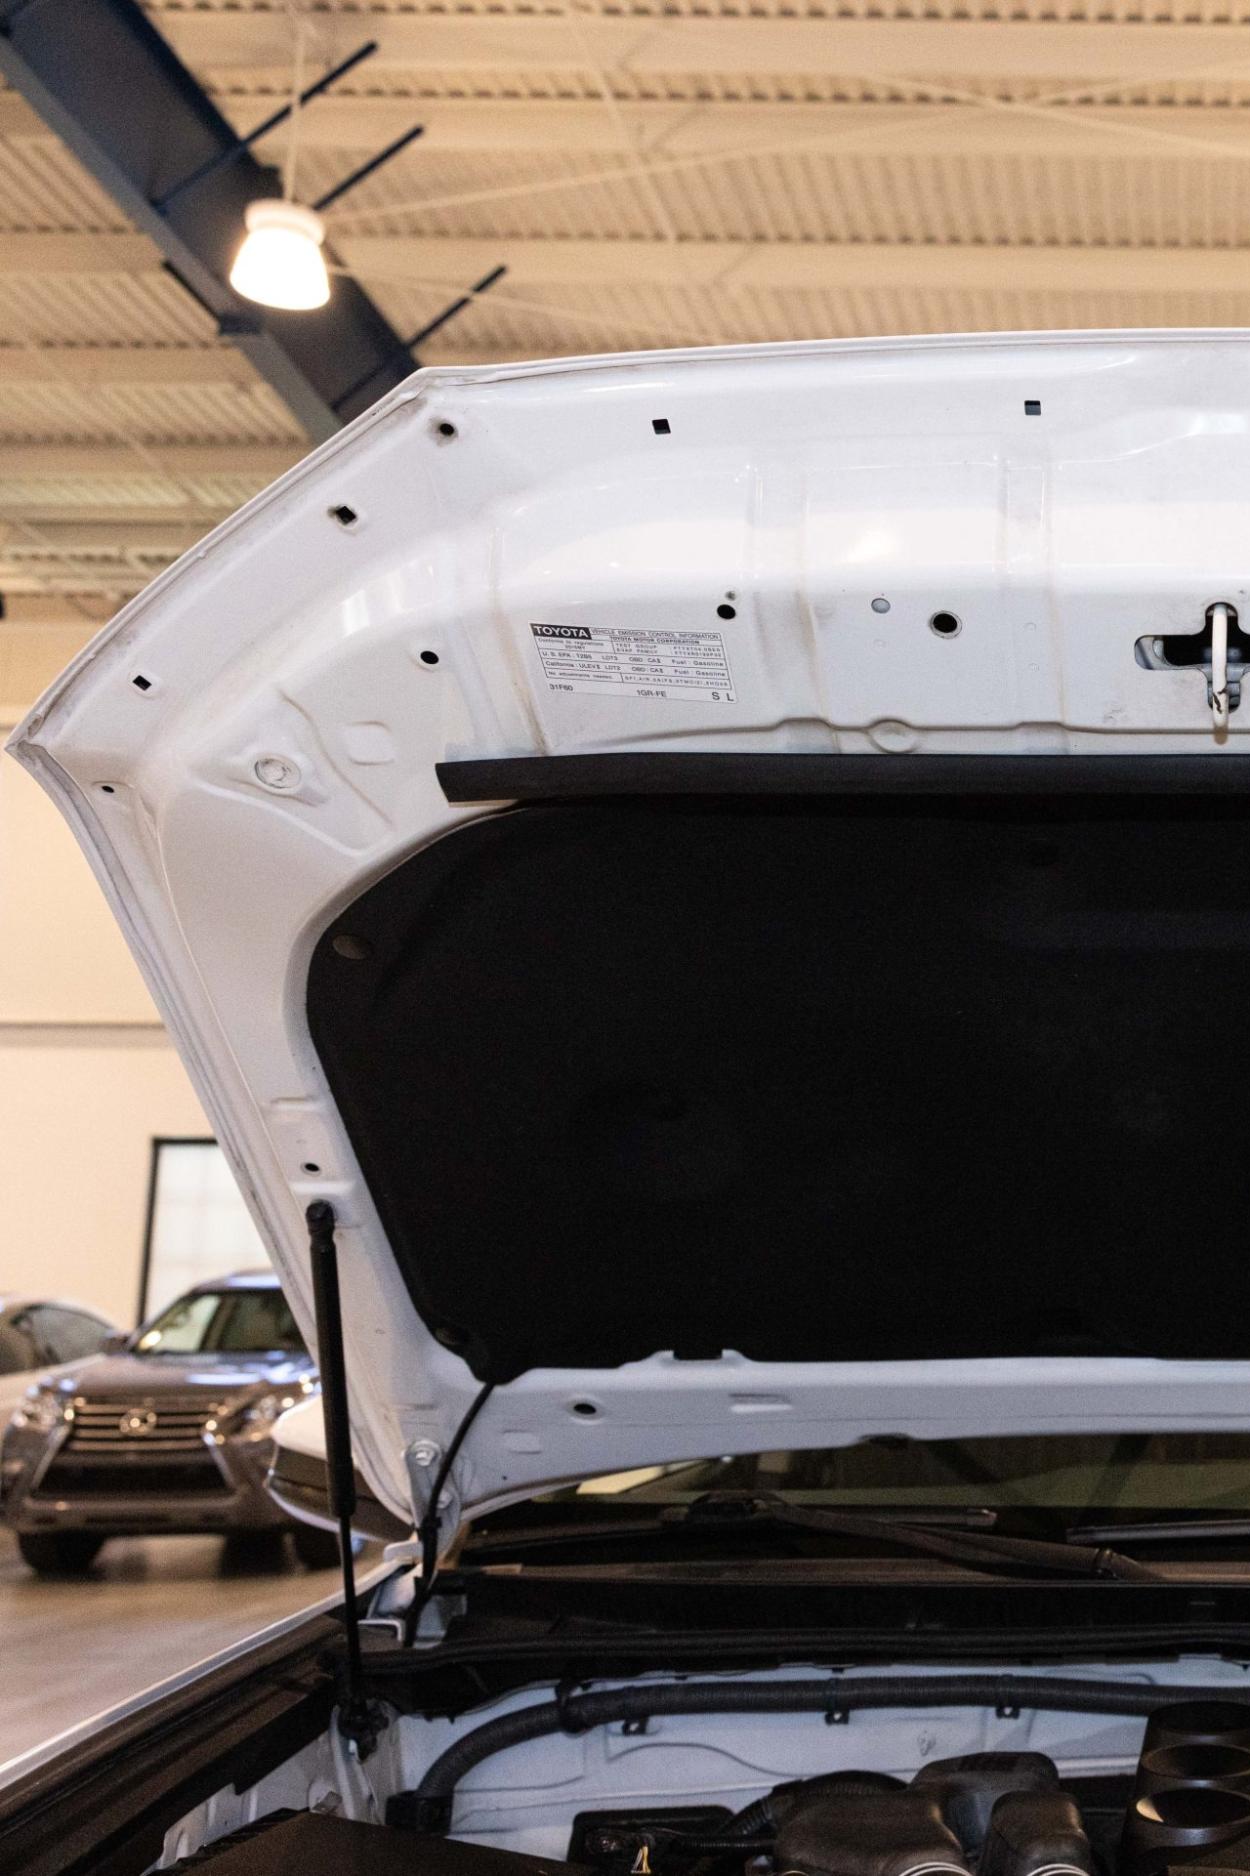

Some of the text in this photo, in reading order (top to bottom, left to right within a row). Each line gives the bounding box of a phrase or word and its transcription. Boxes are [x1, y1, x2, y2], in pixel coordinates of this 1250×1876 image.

[533, 626, 588, 637] TOYOTA
[637, 689, 666, 697] 1GR-FE
[712, 691, 734, 701] S L
